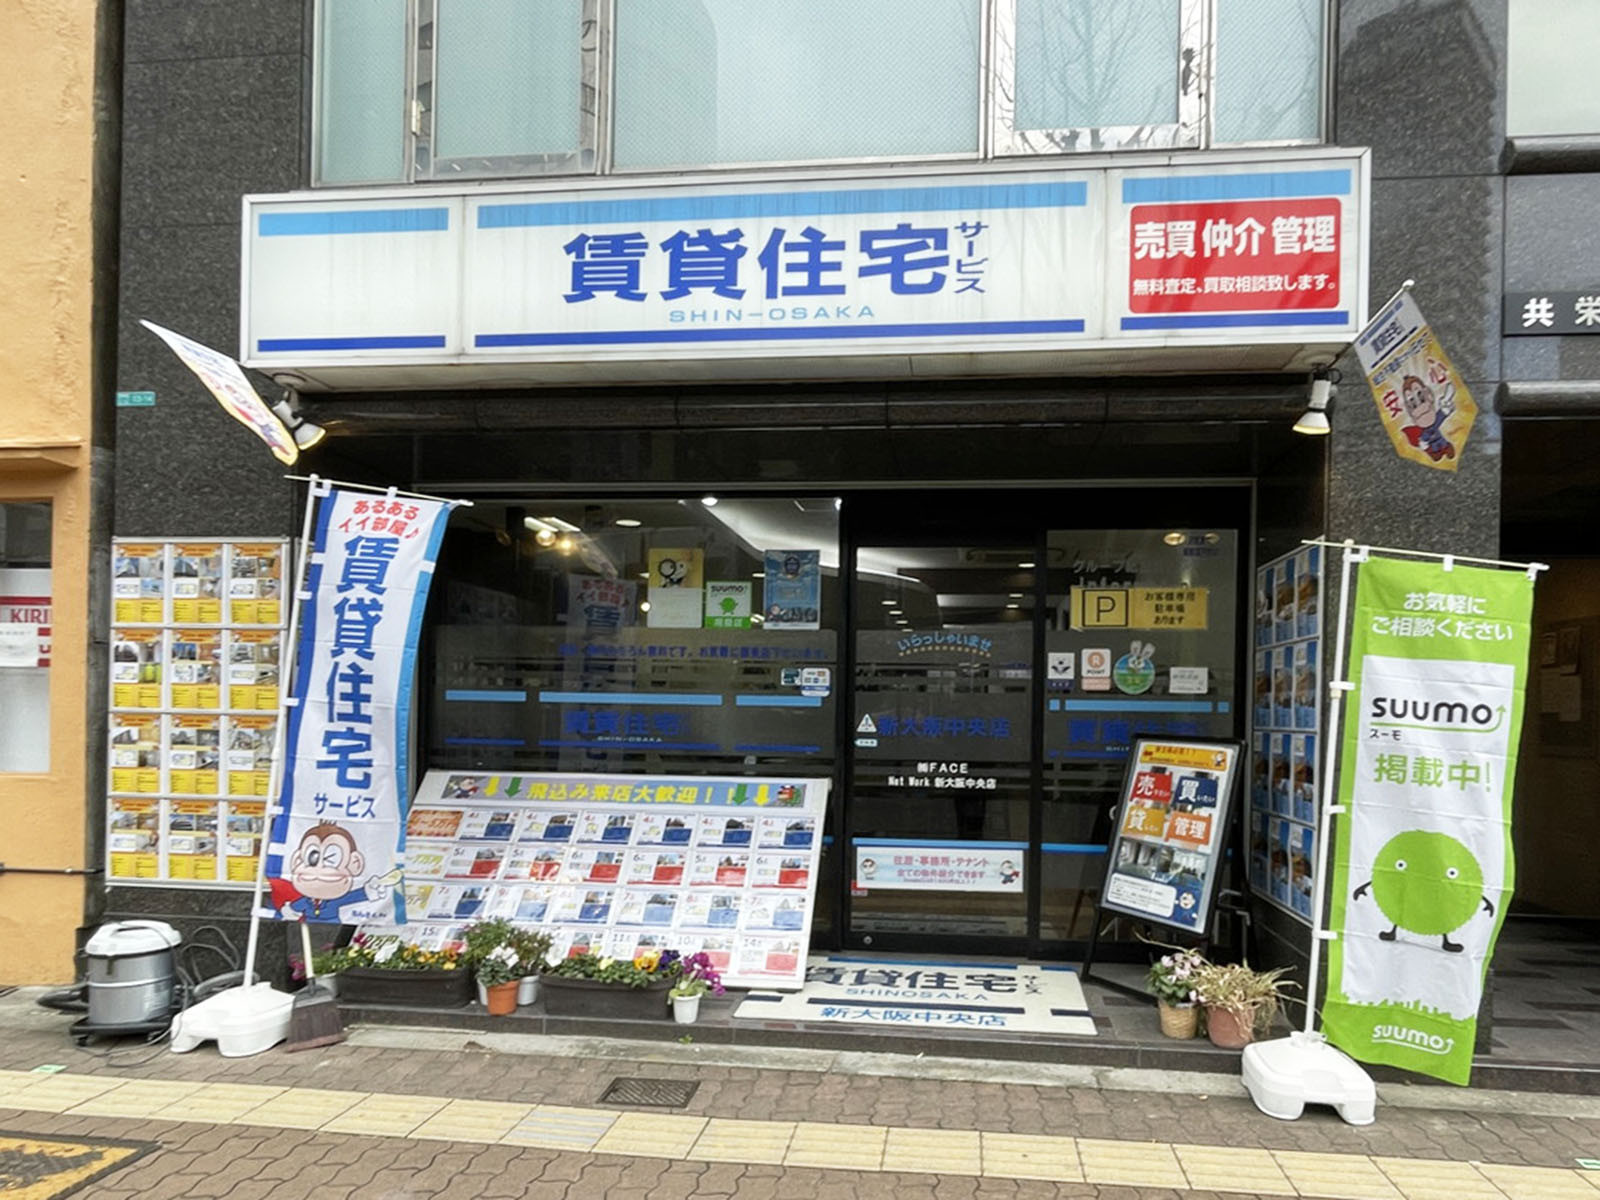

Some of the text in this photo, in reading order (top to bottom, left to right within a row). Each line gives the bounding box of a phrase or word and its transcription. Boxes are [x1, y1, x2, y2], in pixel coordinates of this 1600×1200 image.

[1134, 214, 1336, 260] 売買 仲介 管理
[562, 222, 950, 304] 賃貸住宅
[954, 221, 989, 294] サービス
[1132, 273, 1336, 295] 無料査定、買取相談致します。
[669, 304, 876, 324] SHIN-OSAKA
[353, 499, 421, 520] あるある
[1096, 595, 1116, 623] P
[1403, 591, 1487, 614] お気軽に
[1371, 615, 1513, 640] ご相談ください
[896, 631, 993, 652] いらっしゃいませ
[316, 535, 400, 790] 賃貸住宅
[1371, 697, 1493, 725] suumo
[1369, 728, 1402, 741] スーモ
[313, 793, 377, 819] サービス
[846, 987, 989, 1001] SHINOSAKA
[820, 1006, 1008, 1027] 新大阪中央店
[1372, 1024, 1445, 1050] suumo
